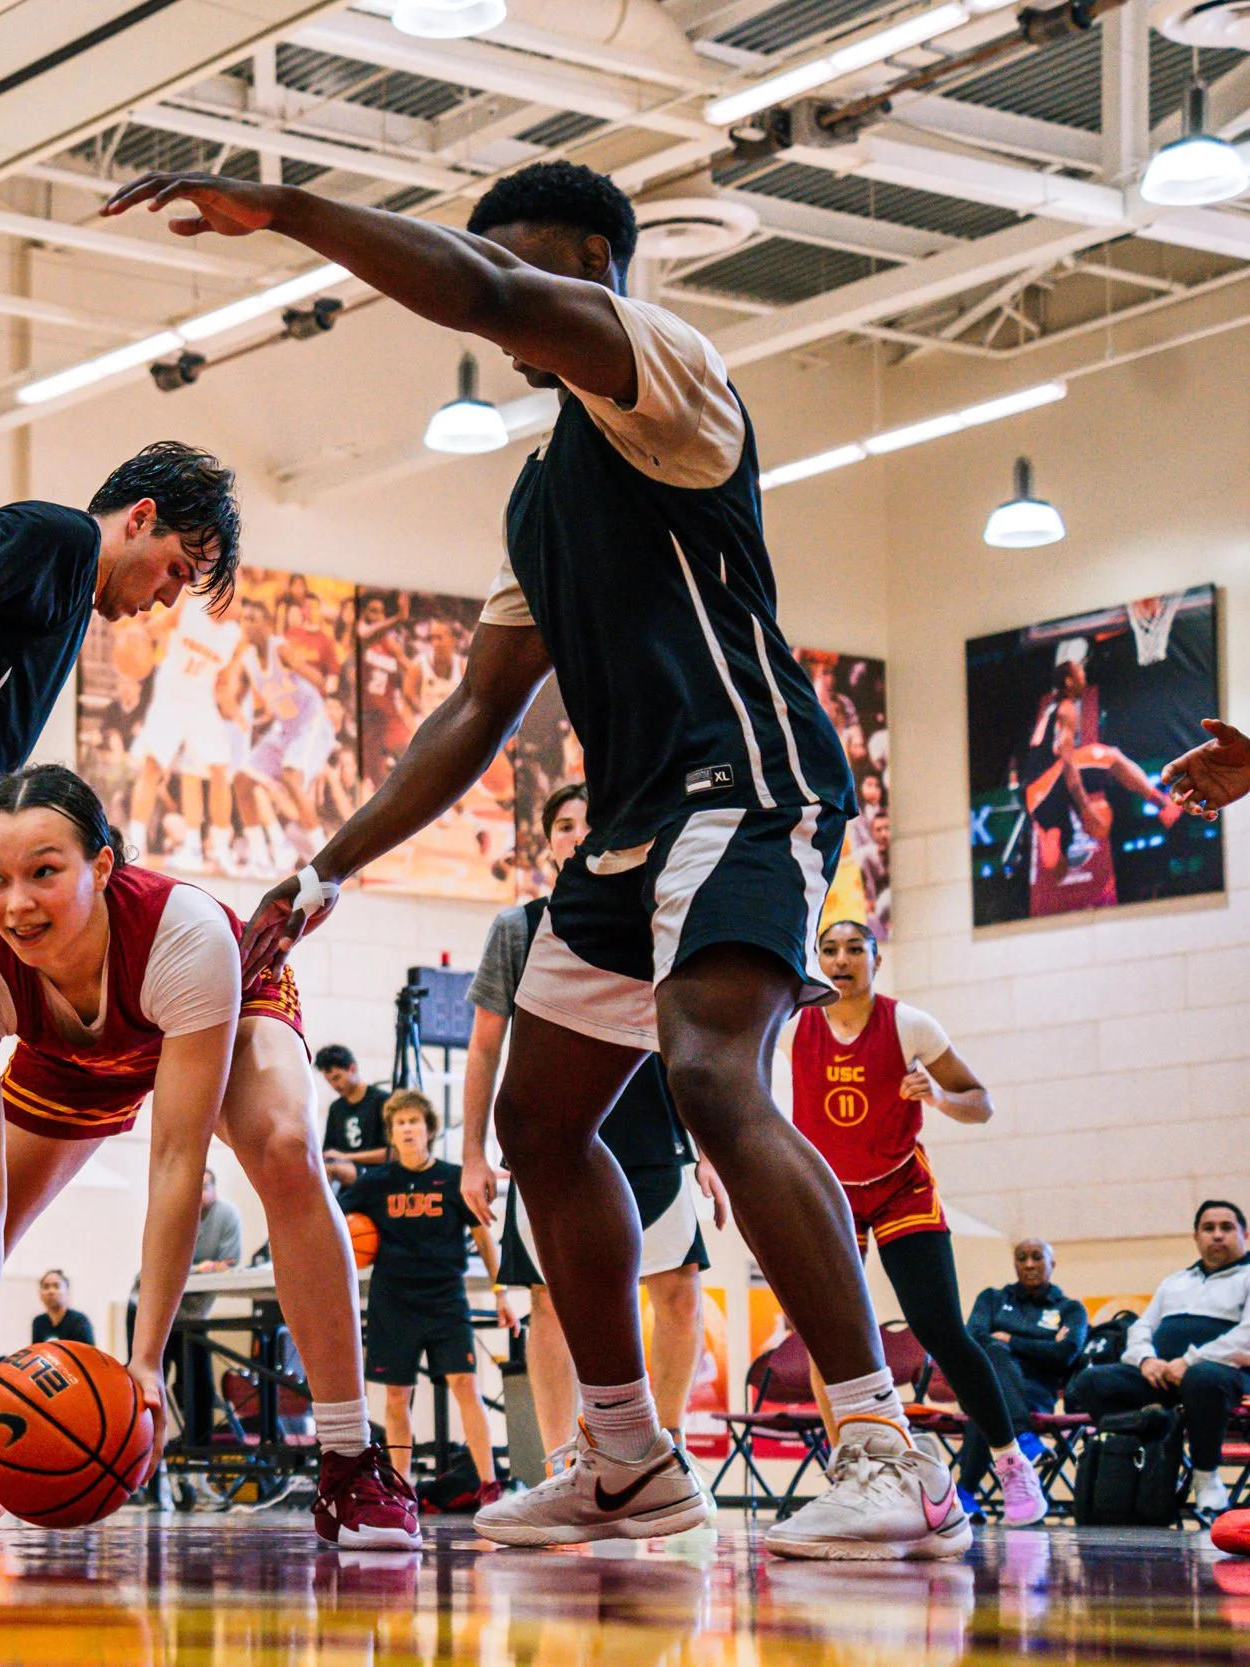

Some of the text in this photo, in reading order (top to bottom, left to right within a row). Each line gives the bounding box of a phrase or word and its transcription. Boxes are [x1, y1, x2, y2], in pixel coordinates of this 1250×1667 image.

[714, 771, 731, 782] XL
[827, 1066, 865, 1082] USC
[838, 1094, 855, 1118] 11
